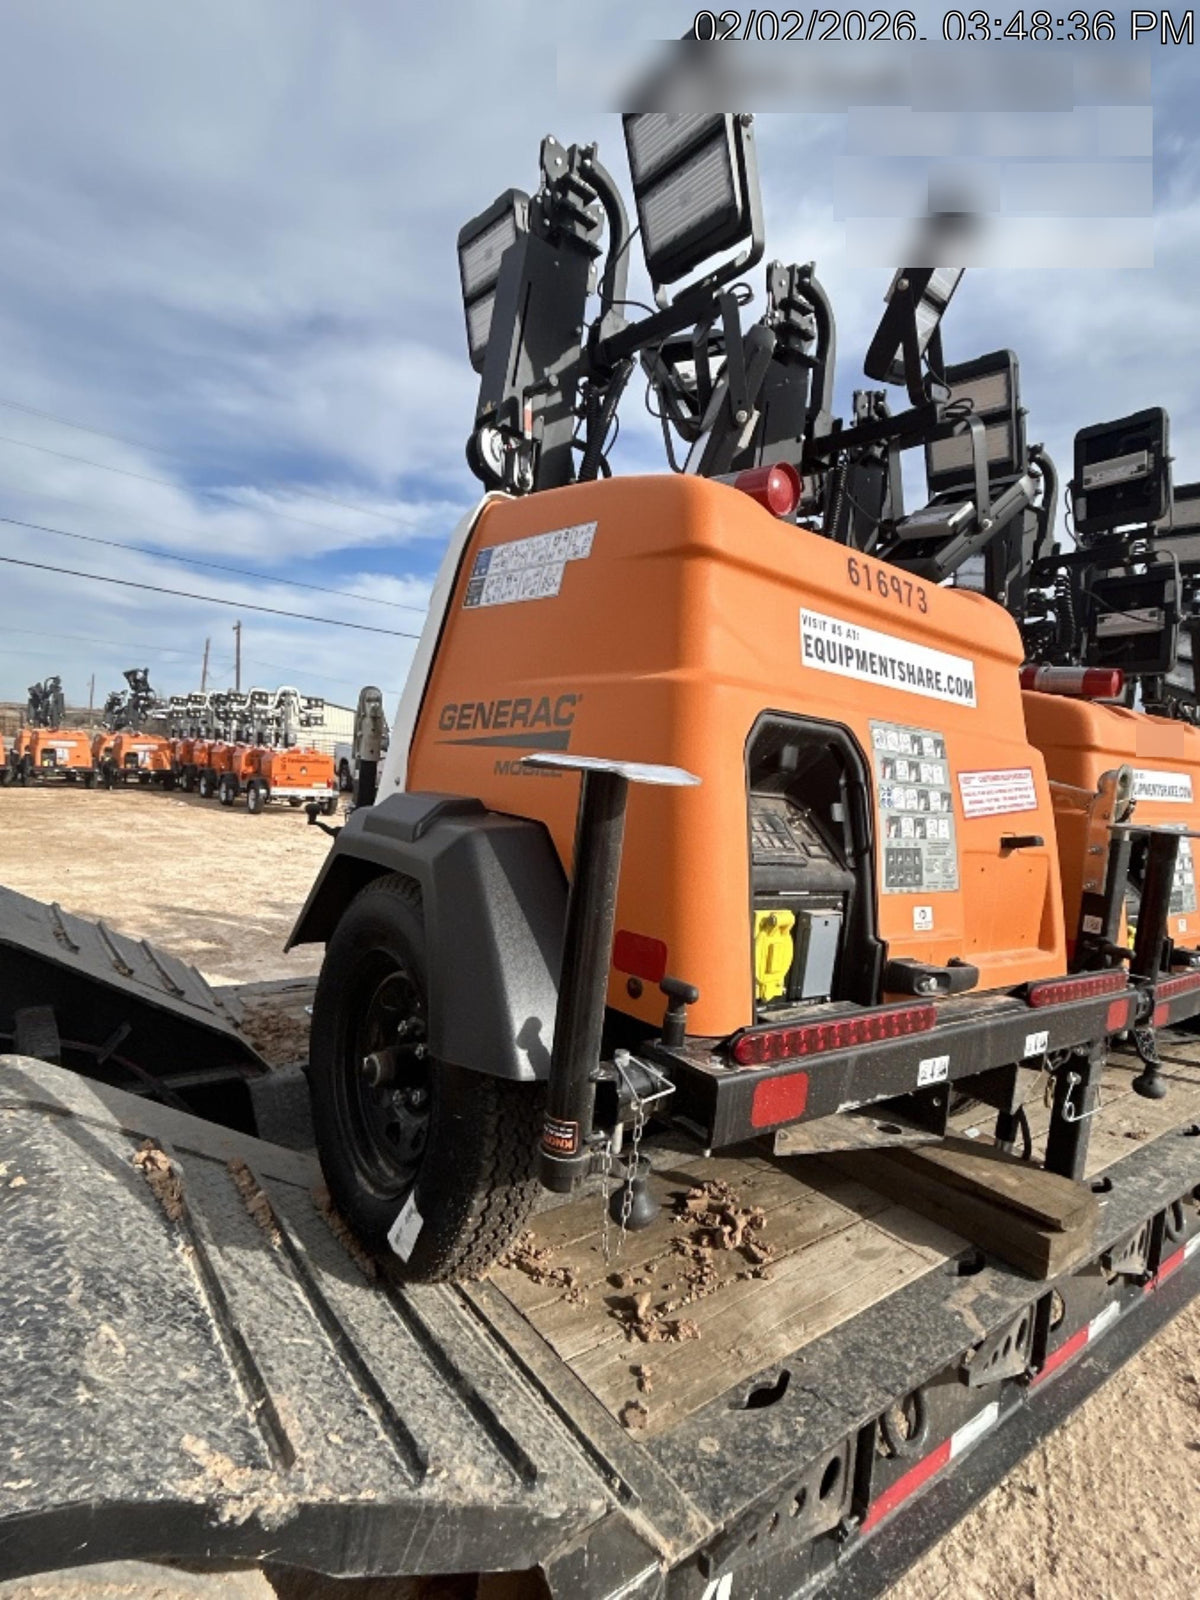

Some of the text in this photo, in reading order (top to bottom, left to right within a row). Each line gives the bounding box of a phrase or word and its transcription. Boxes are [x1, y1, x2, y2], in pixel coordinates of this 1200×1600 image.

[847, 557, 928, 614] 616973
[802, 614, 860, 641] VISIT US AT:
[803, 634, 974, 699] EQUIPMENTSHARE.COM
[438, 693, 577, 730] GENERAC
